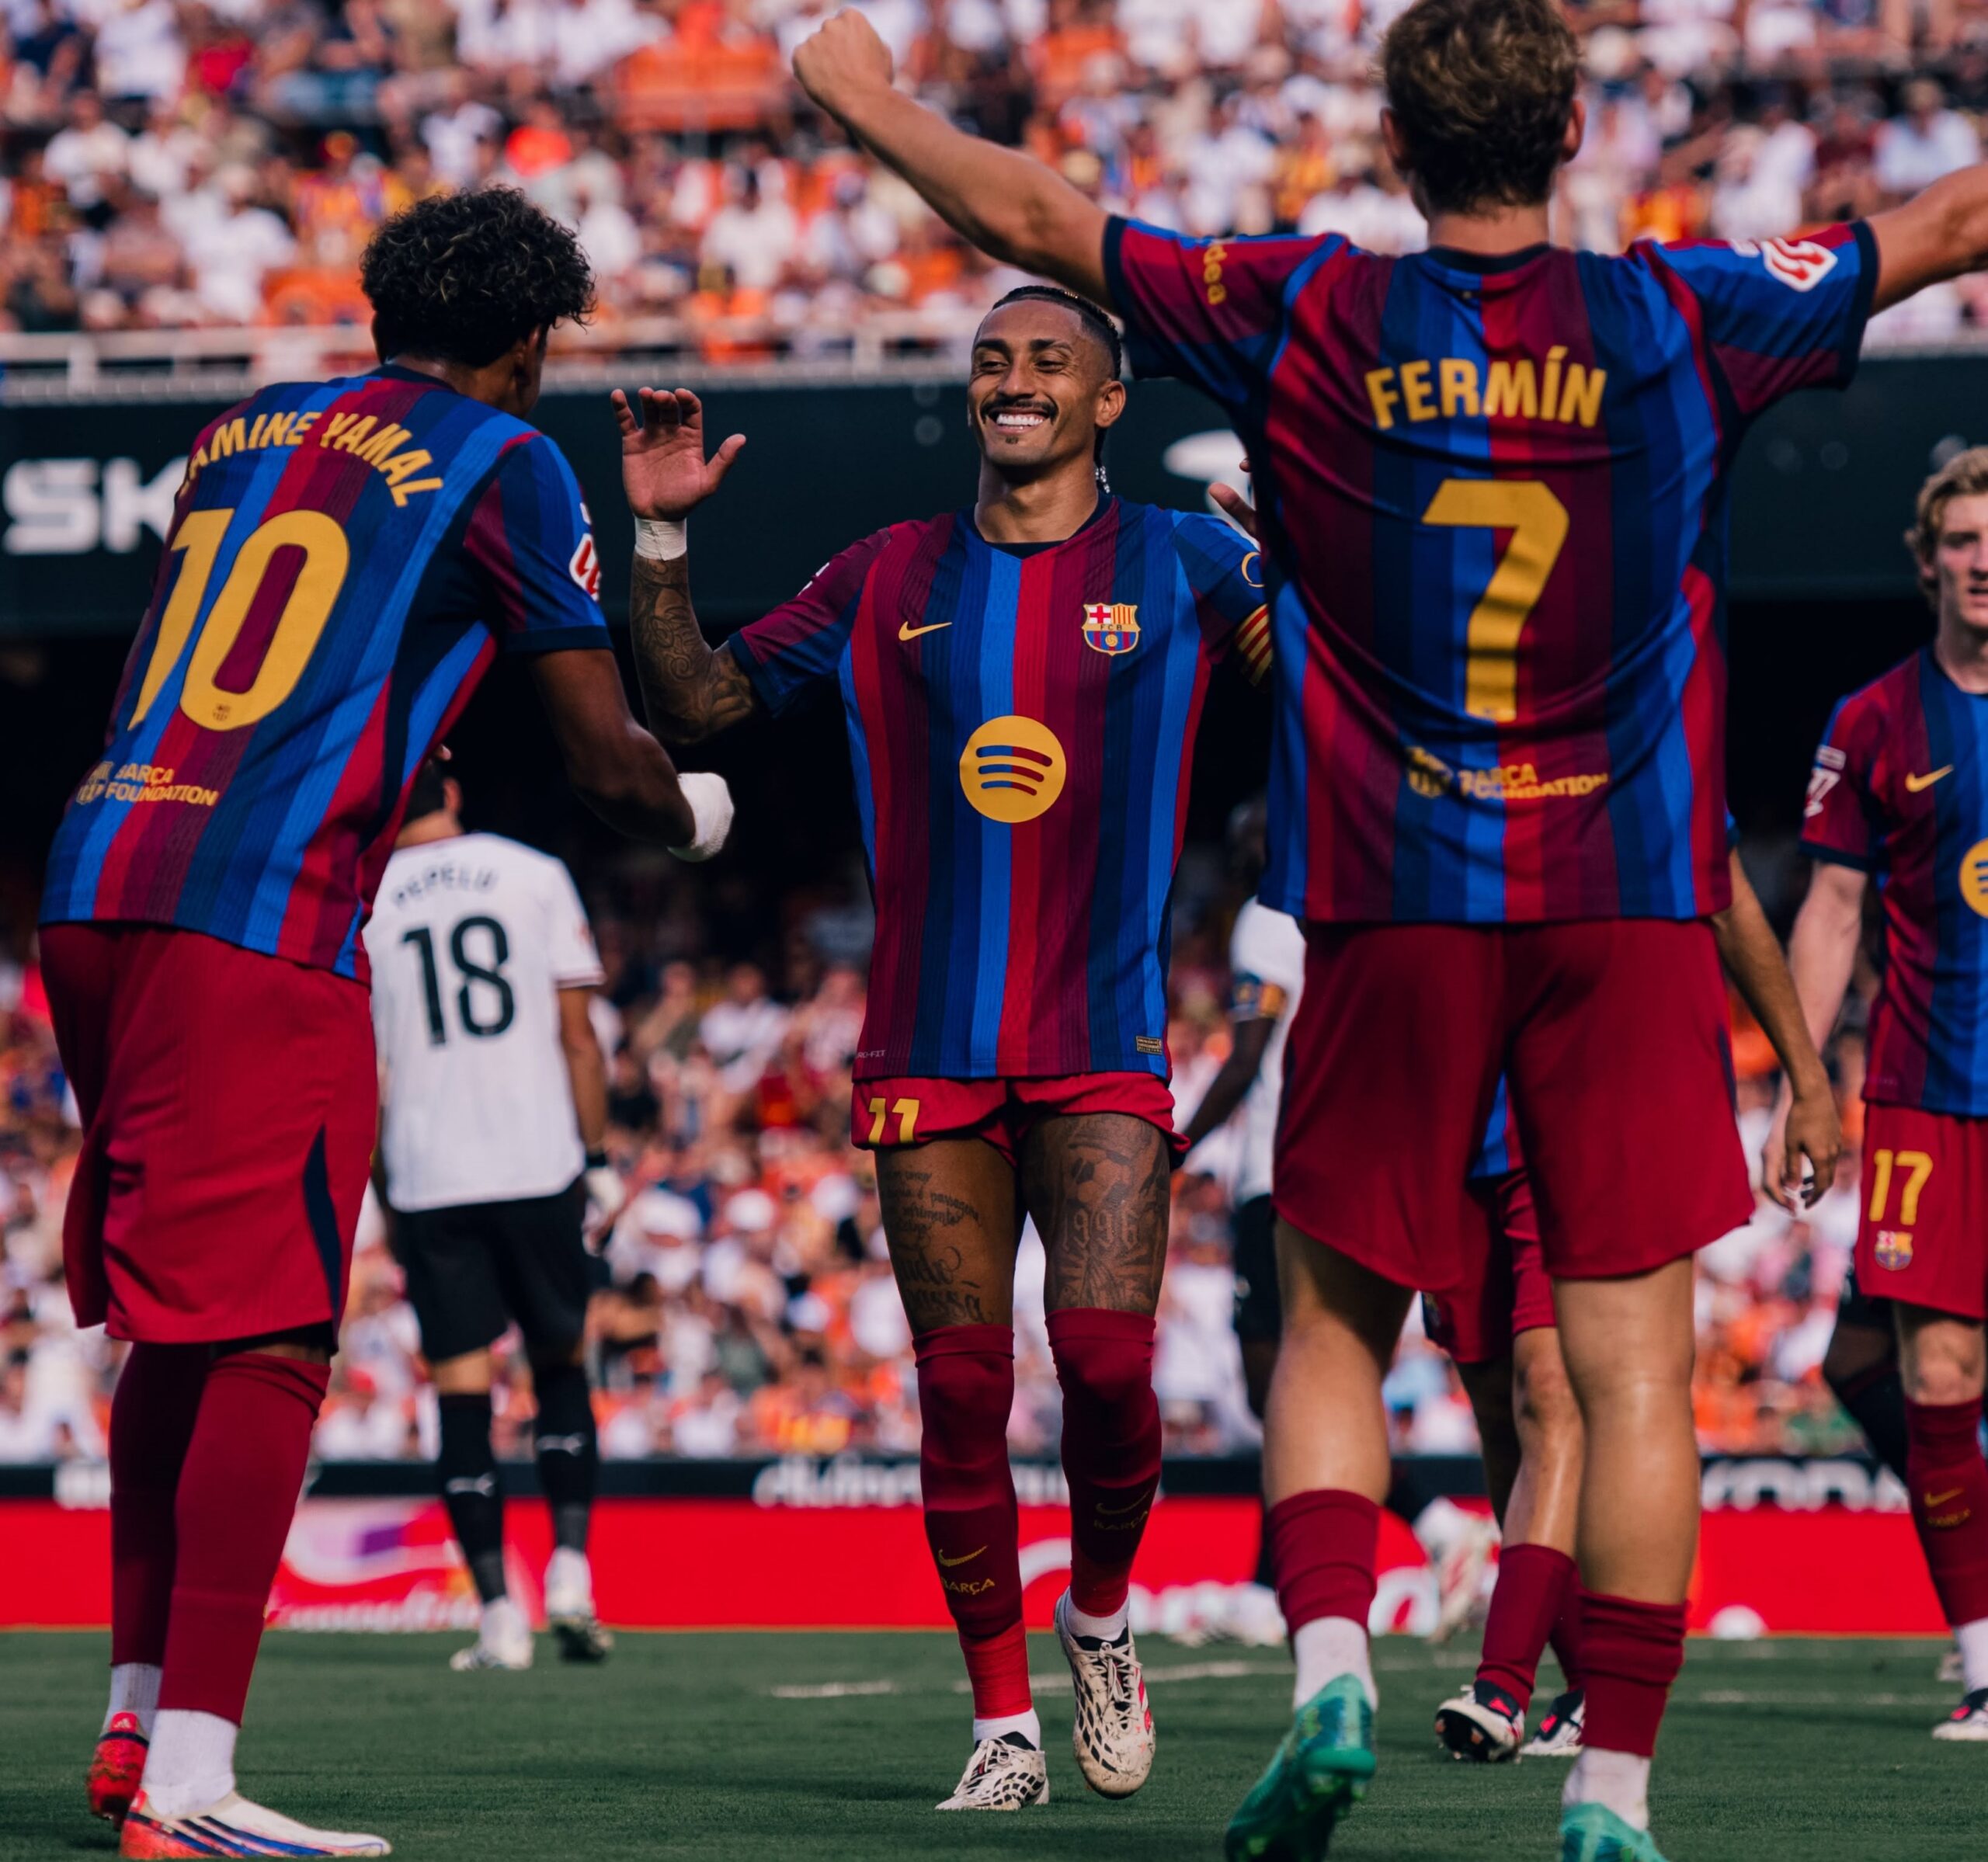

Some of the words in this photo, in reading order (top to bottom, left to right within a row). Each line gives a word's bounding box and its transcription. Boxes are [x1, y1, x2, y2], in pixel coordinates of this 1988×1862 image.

[1364, 346, 1607, 429] FERMÍN
[319, 412, 443, 508] YAMAL
[127, 508, 350, 731] 10
[1420, 478, 1570, 723] 7
[105, 781, 219, 806] FOUNDATION
[403, 915, 514, 1044] 18
[868, 1097, 920, 1144] 11
[1869, 1149, 1934, 1225] 17
[1062, 1209, 1139, 1252] 1996
